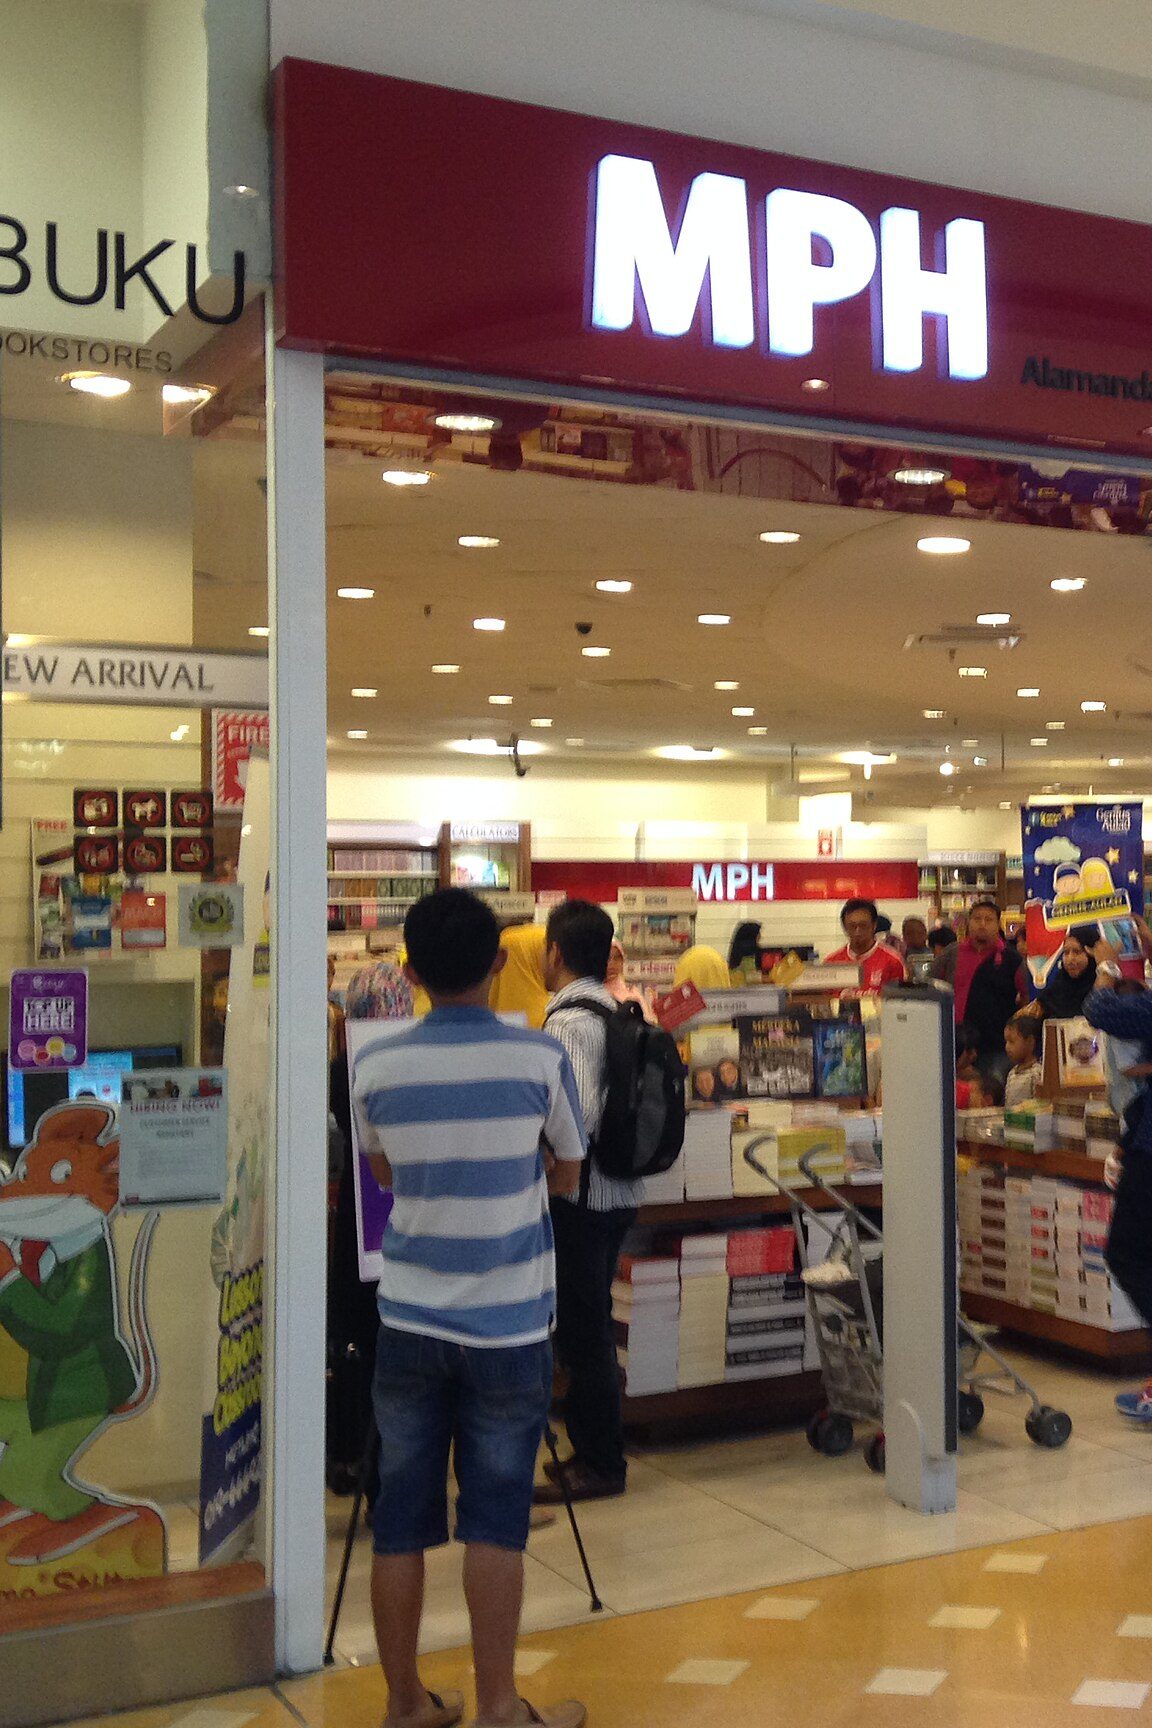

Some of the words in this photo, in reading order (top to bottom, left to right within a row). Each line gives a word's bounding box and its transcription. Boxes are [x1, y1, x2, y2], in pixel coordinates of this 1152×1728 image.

[0, 215, 246, 326] BUKU
[588, 153, 989, 381] MPH
[0, 331, 173, 373] OKSTORES
[70, 657, 214, 692] ARRIVAL
[692, 862, 774, 902] MPH
